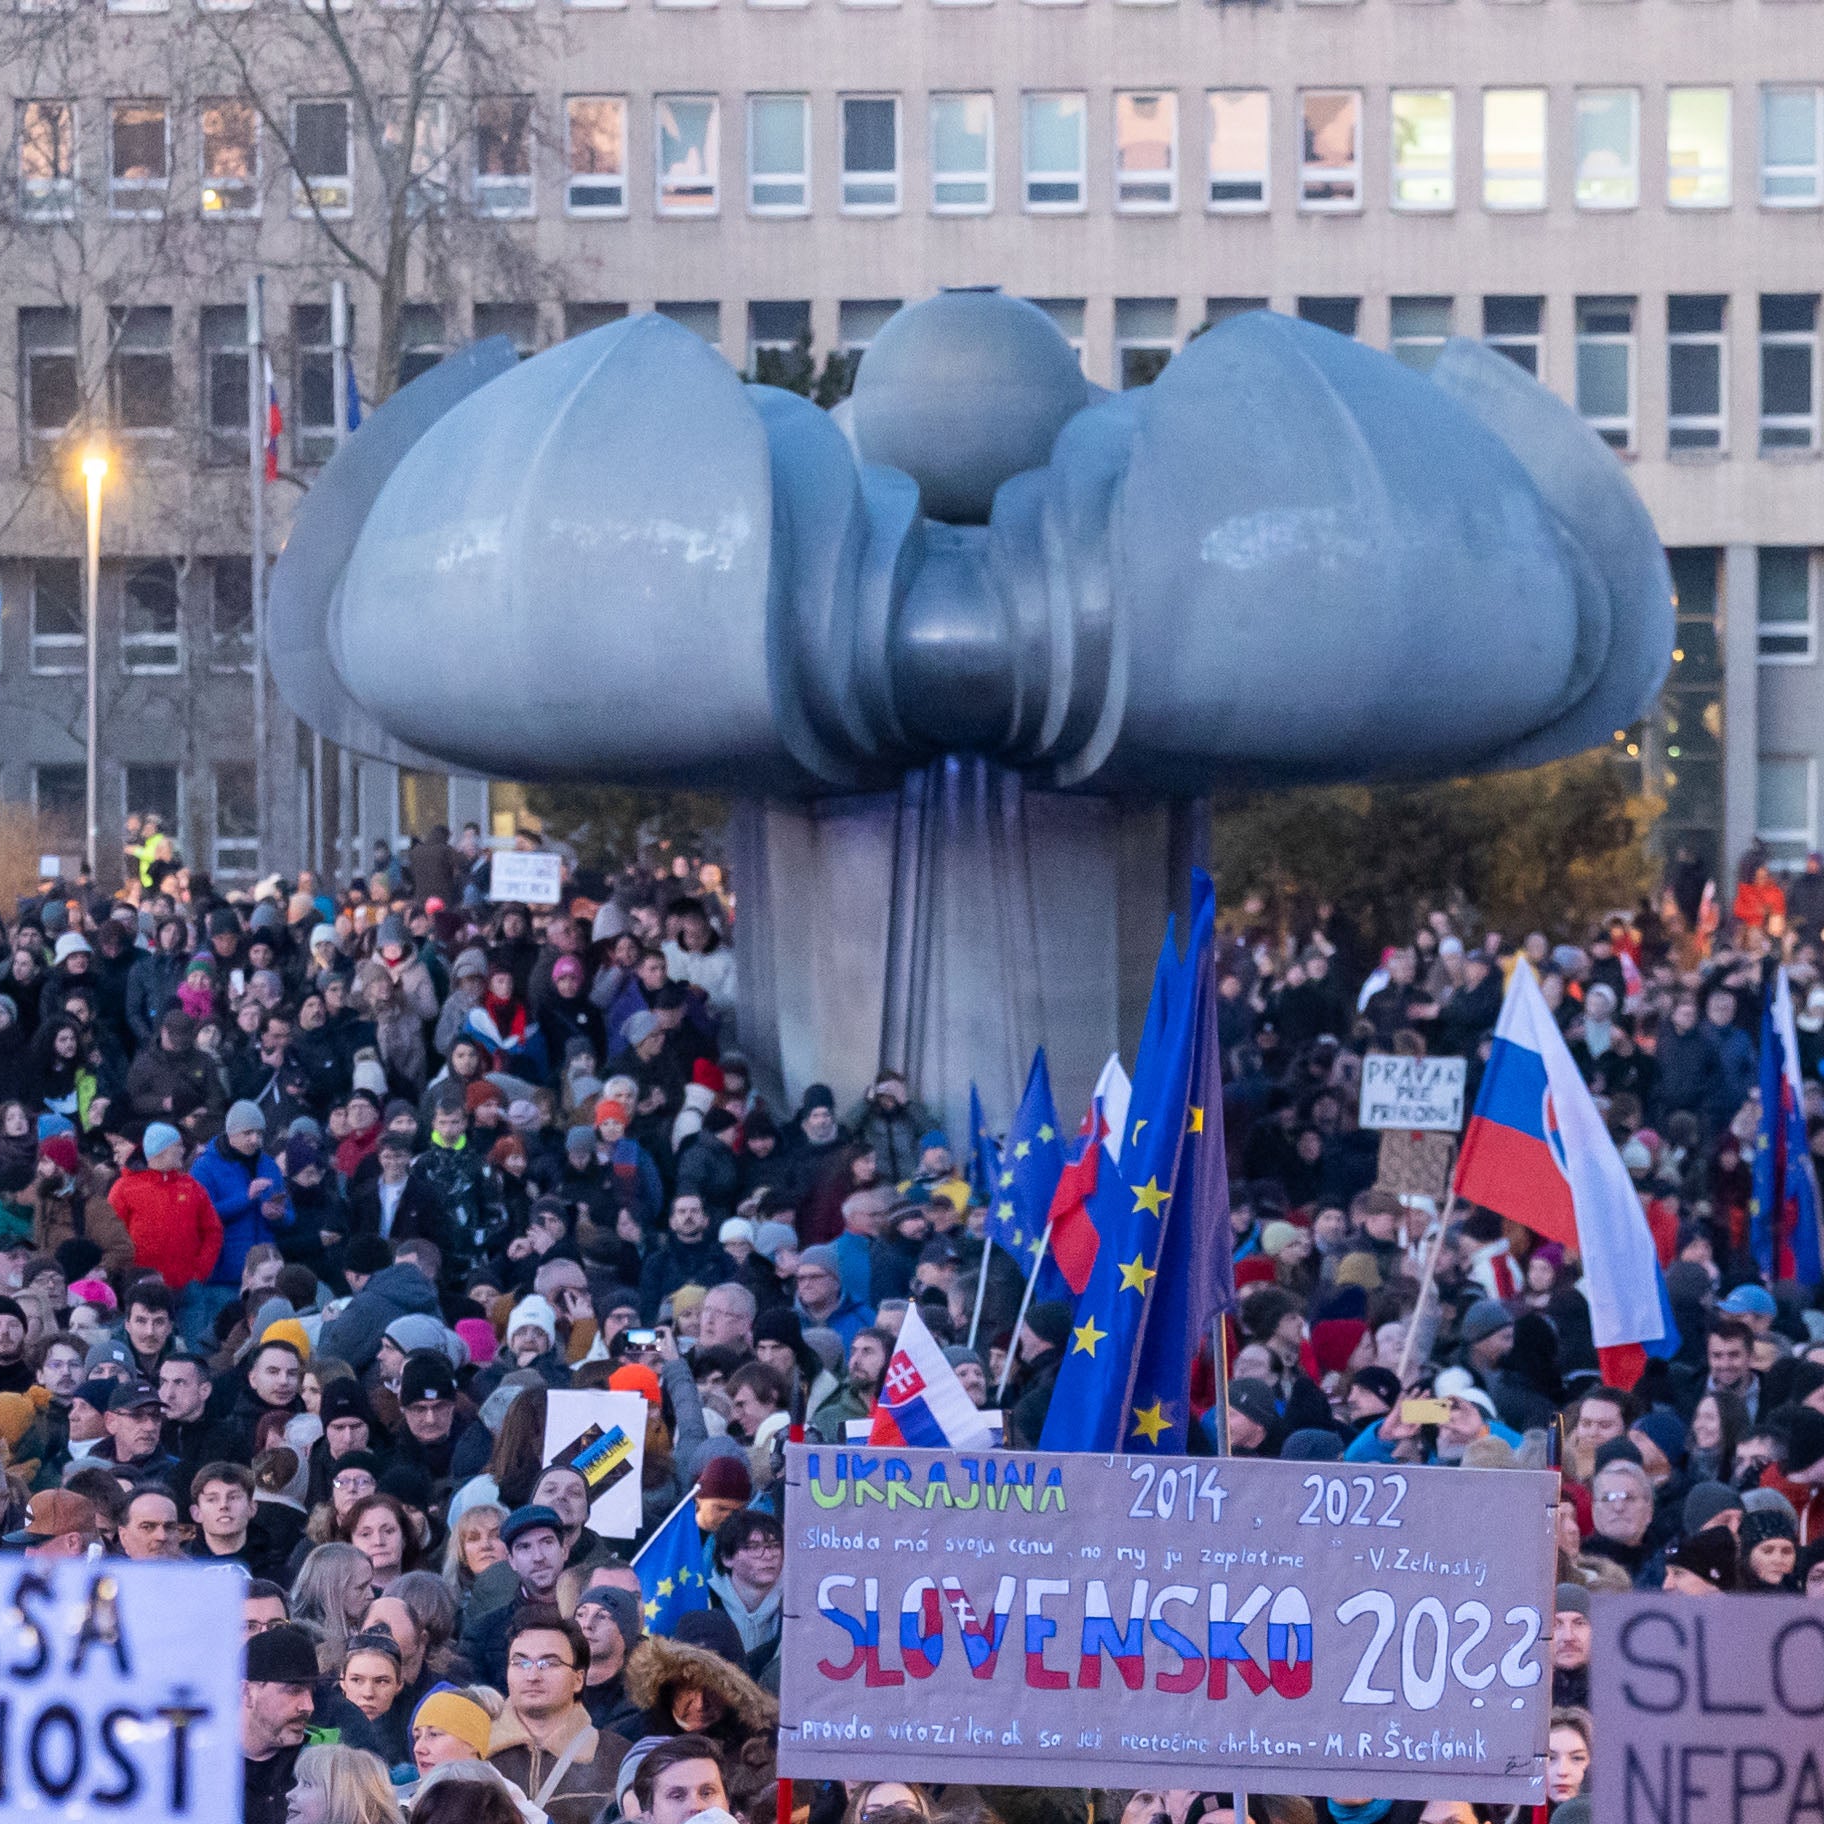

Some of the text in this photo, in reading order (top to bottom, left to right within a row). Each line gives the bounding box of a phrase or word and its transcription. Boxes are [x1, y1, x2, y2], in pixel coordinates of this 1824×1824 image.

[807, 1453, 1068, 1513] UKRAJINA
[1298, 1474, 1409, 1528] 2022
[894, 1528, 929, 1552] má
[945, 1537, 995, 1558] svoju
[1080, 1545, 1102, 1560] no
[1116, 1546, 1146, 1570] my
[1163, 1548, 1182, 1570] ju
[816, 1573, 1313, 1701] SLOVENSKO
[966, 1715, 994, 1744] len
[1002, 1721, 1024, 1746] ak
[1039, 1730, 1064, 1748] sa
